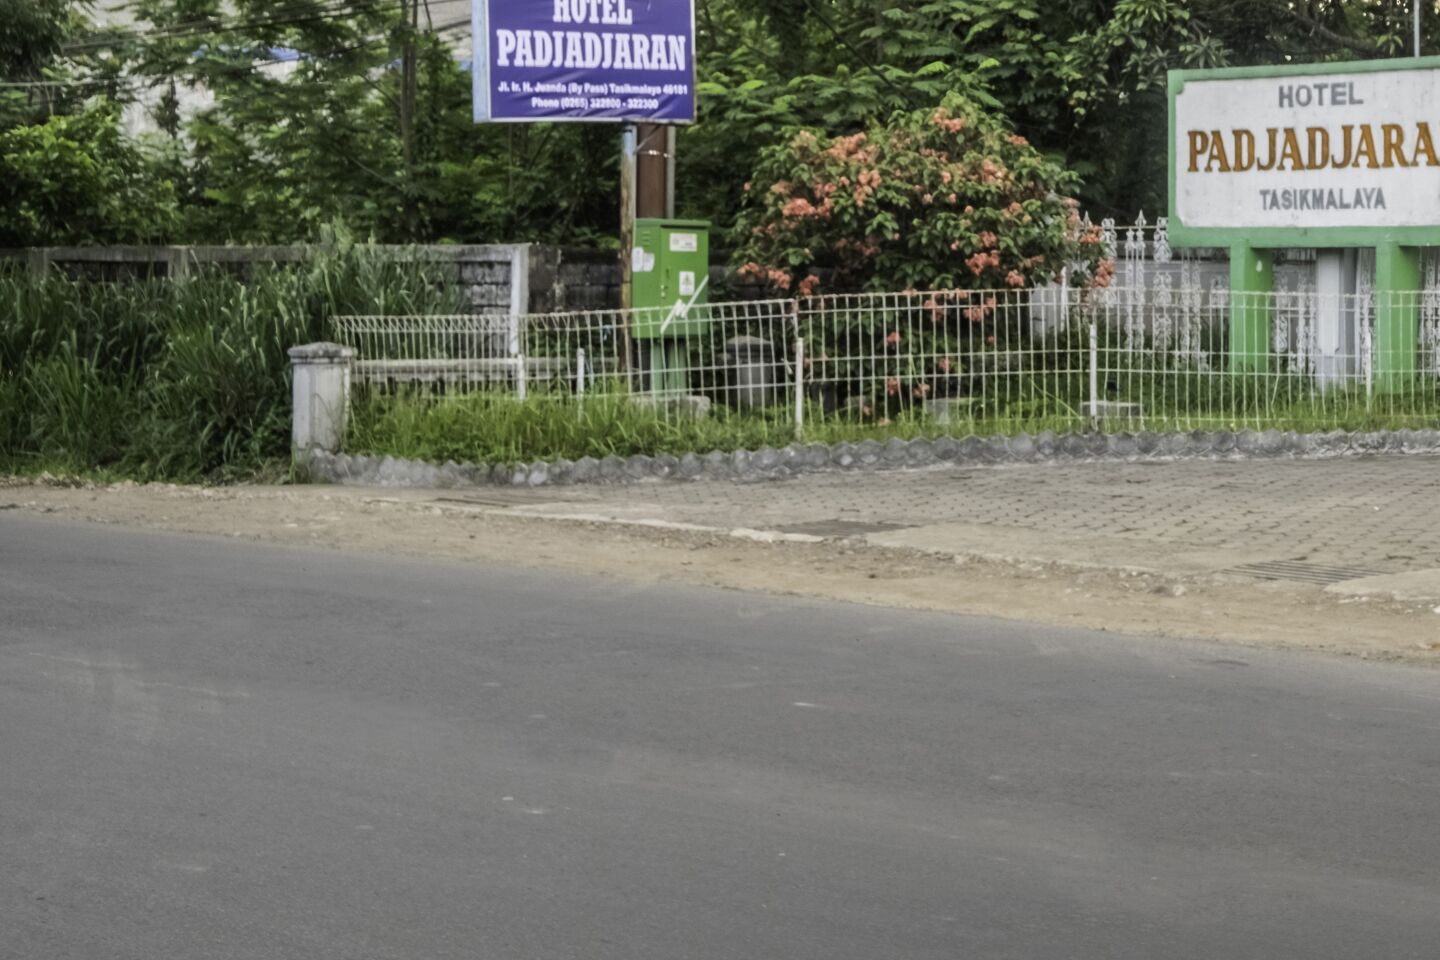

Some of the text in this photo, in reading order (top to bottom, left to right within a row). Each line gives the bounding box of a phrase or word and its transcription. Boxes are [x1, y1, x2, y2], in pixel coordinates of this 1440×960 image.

[496, 29, 686, 71] PADJADJARAN
[498, 81, 510, 93] Jl.
[522, 81, 533, 93] H.
[534, 82, 567, 93] Juanda
[568, 82, 583, 95] (By
[584, 82, 608, 95] Pass)
[609, 83, 662, 96] Tasikmalaya
[1278, 82, 1364, 108] HOTEL
[531, 97, 560, 108] Phone
[1259, 187, 1387, 211] TASIKMALAYA
